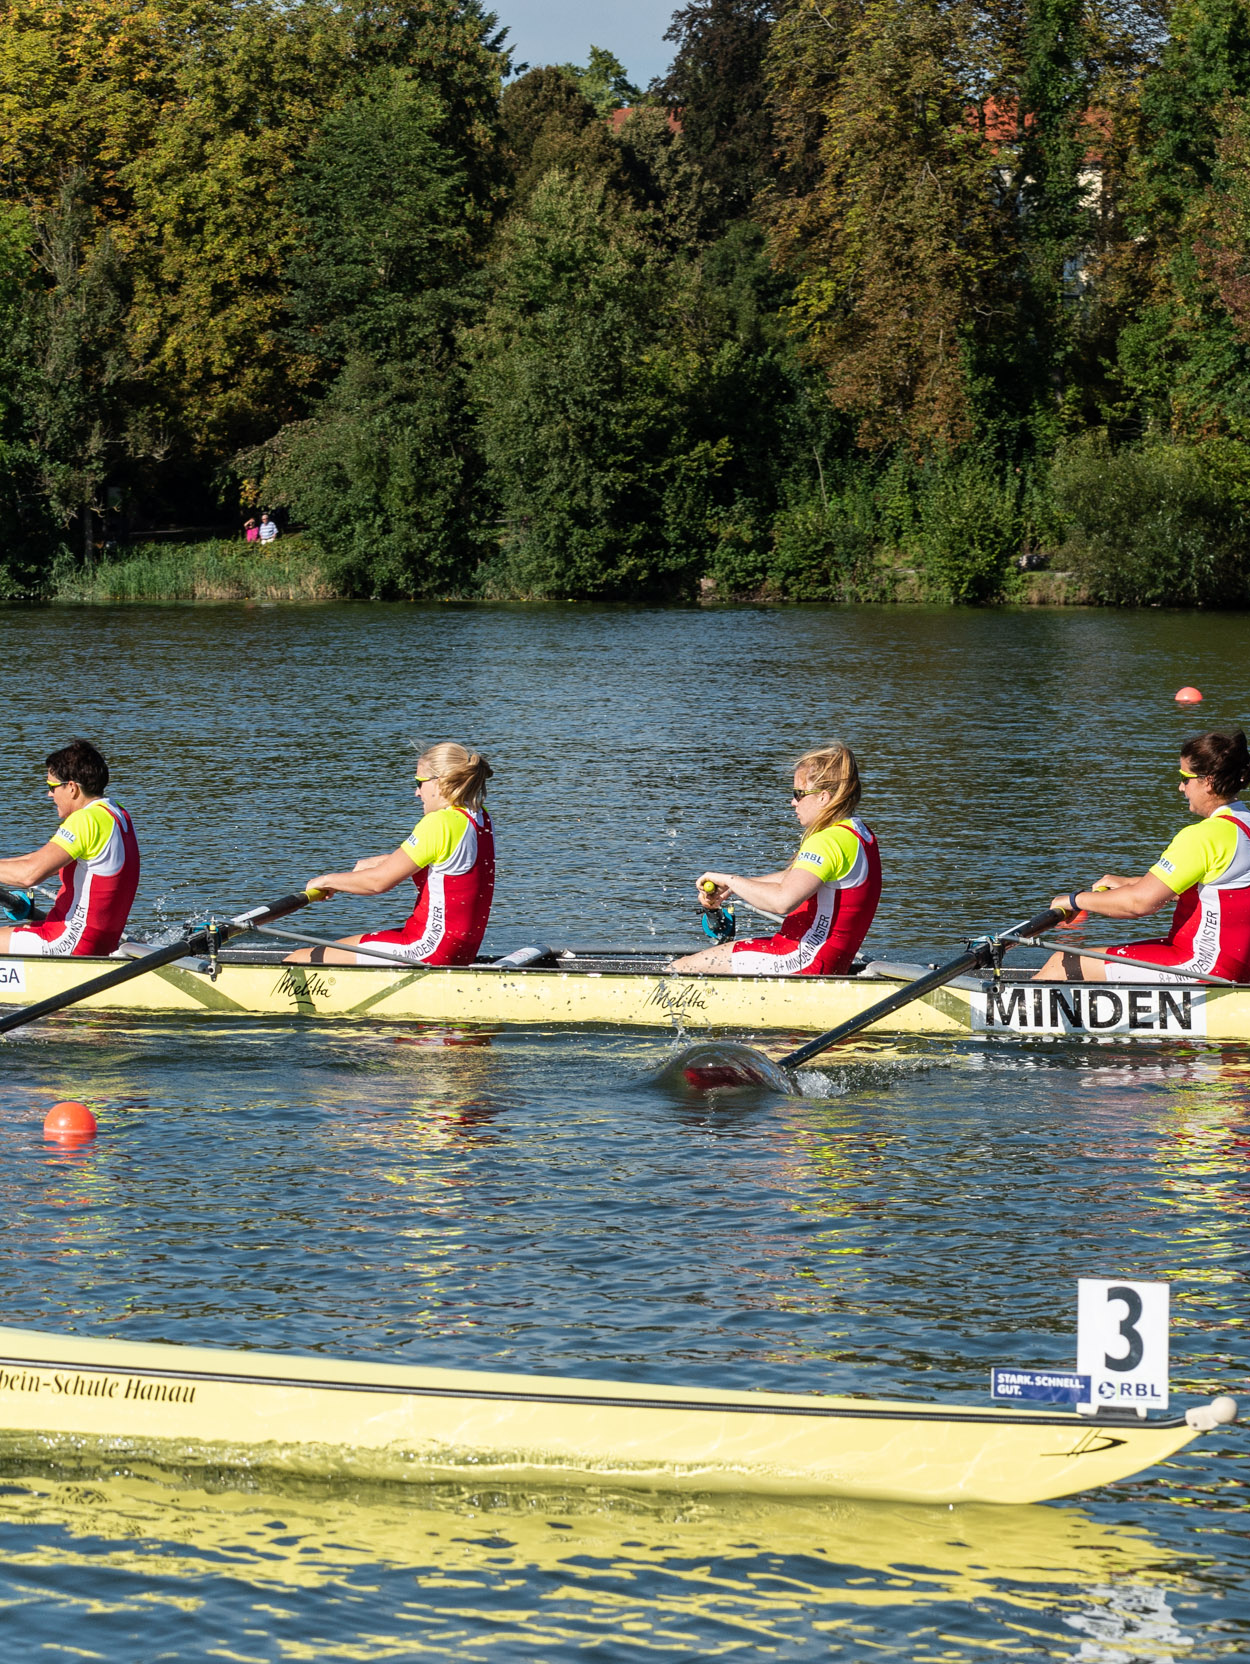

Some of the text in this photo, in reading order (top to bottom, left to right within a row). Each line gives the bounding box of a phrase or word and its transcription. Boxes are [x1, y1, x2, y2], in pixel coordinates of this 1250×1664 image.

[803, 851, 822, 865] RBL
[985, 988, 1193, 1030] MINDEN
[1104, 1285, 1144, 1373] 3
[997, 1373, 1085, 1389] STARK. SCHNELL.
[124, 1378, 197, 1403] Hanau
[997, 1384, 1023, 1396] GUT.
[1120, 1382, 1162, 1398] RBL
